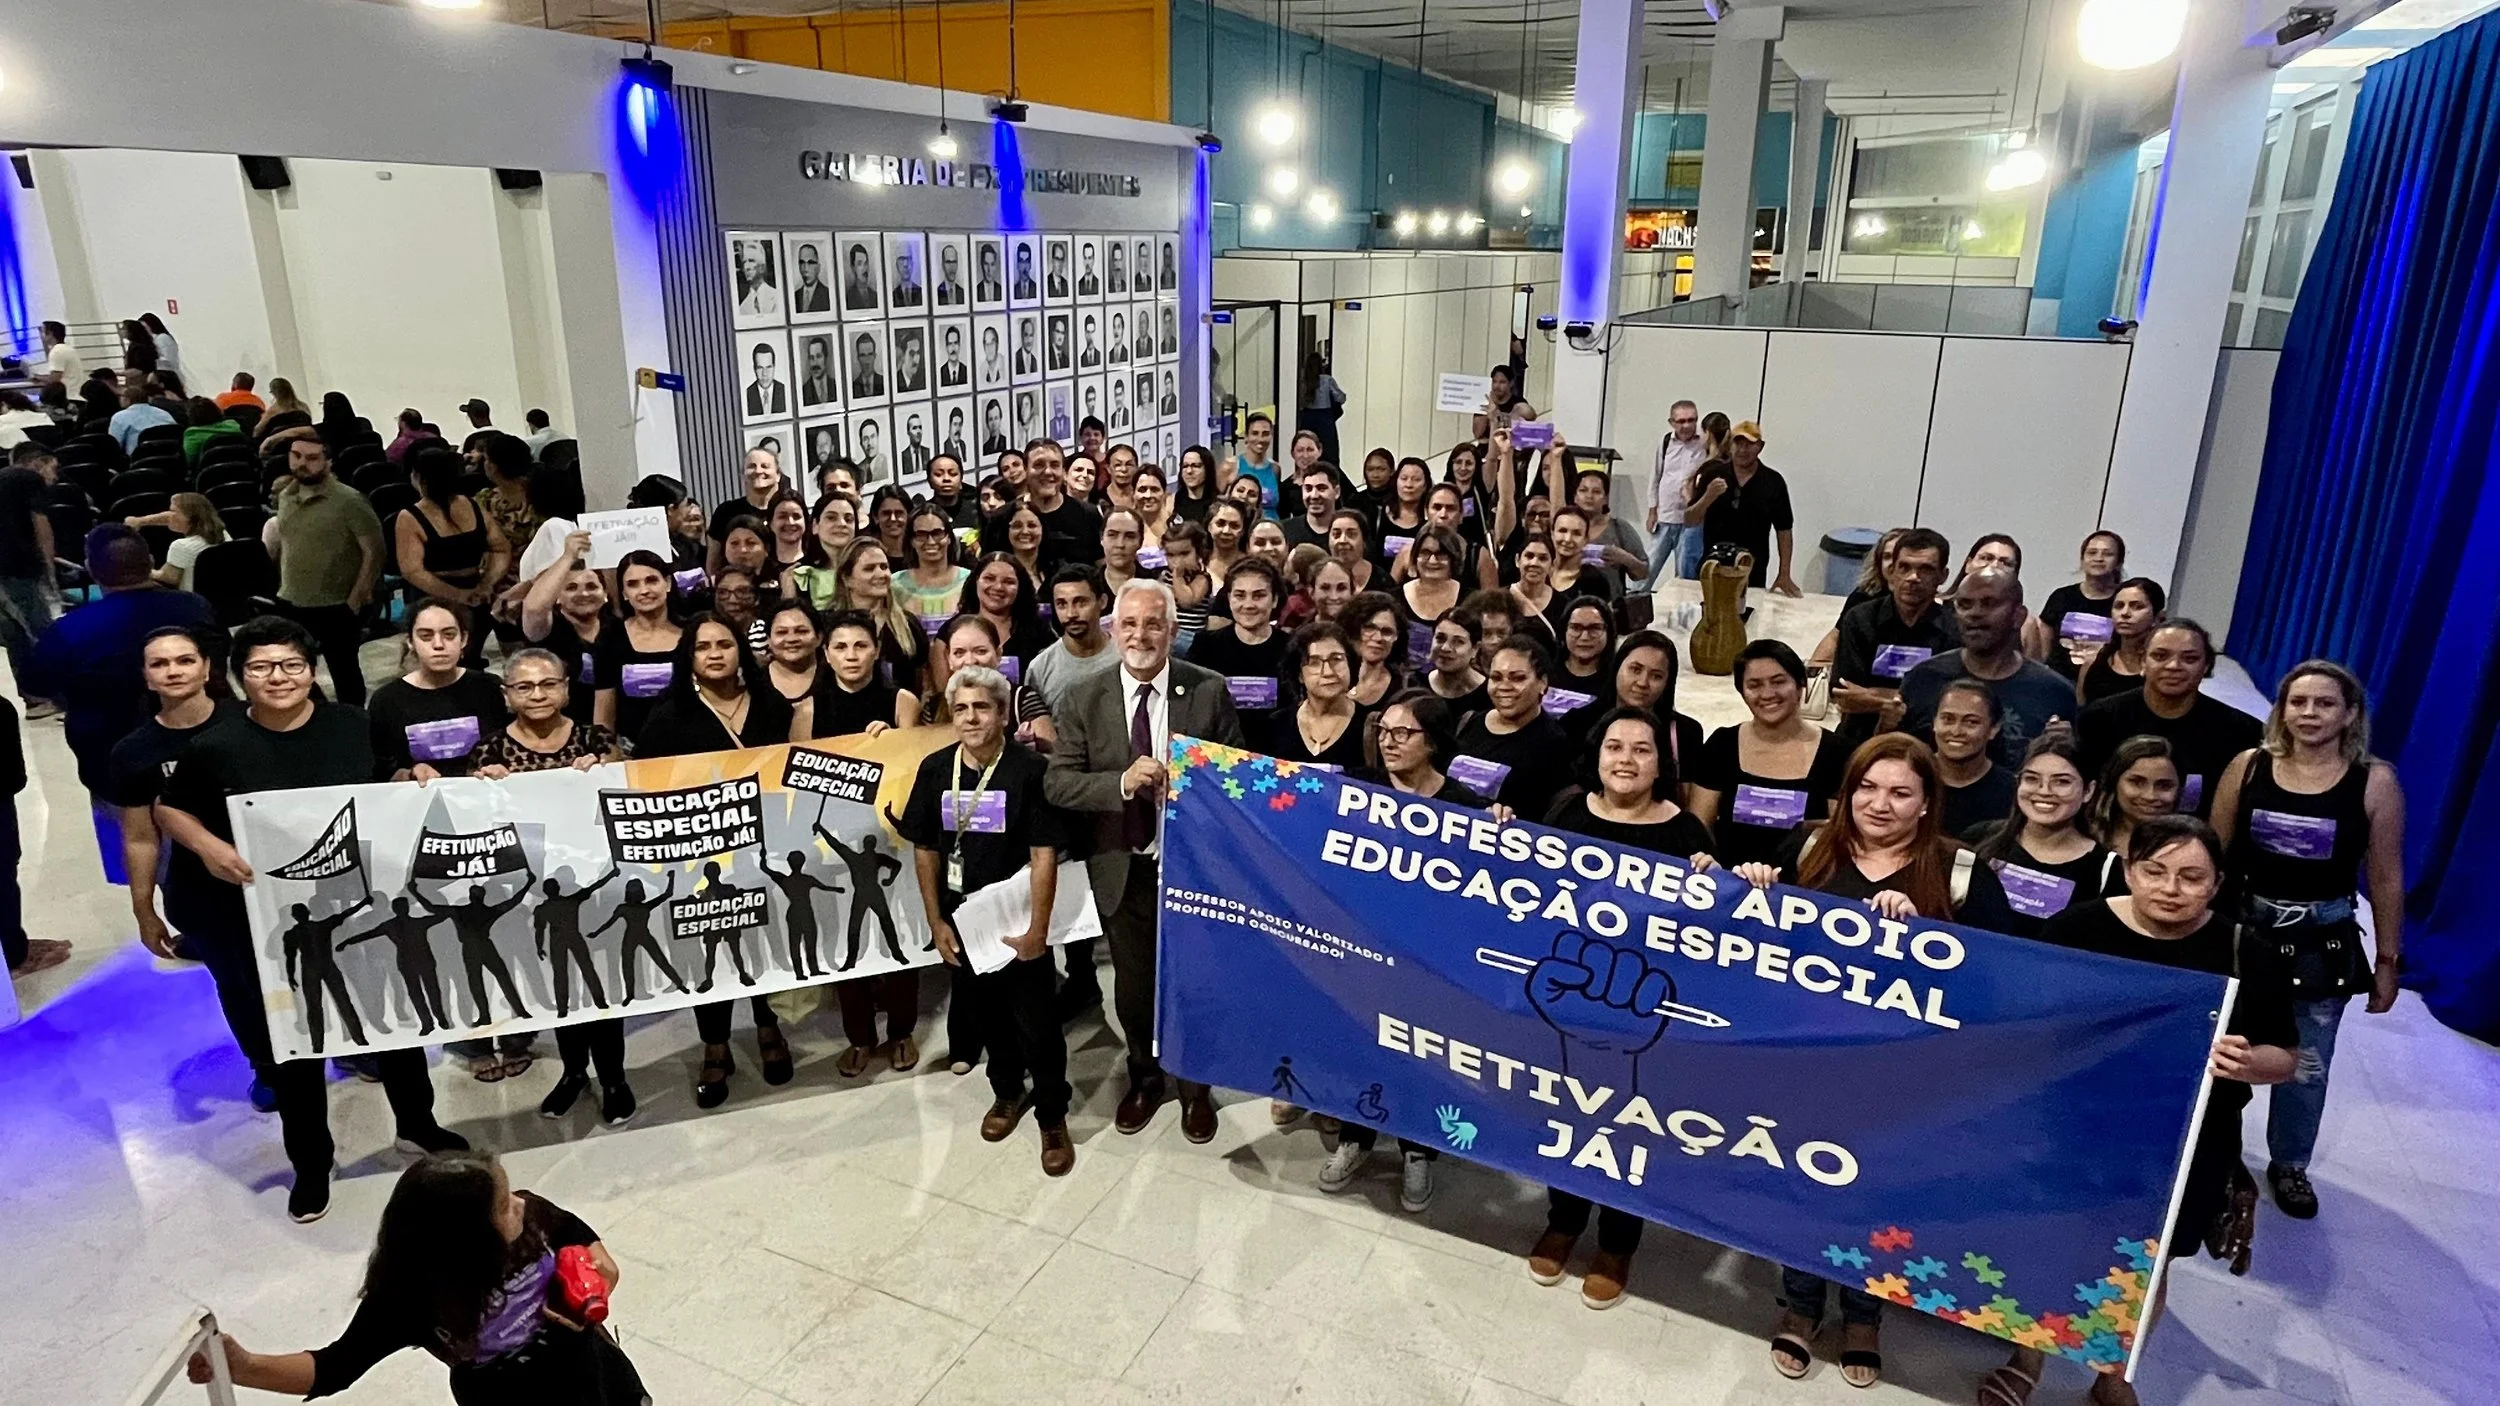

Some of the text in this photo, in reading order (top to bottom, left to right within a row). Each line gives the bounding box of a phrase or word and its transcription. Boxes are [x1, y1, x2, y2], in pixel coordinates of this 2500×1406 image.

[800, 150, 929, 186] GALERIA
[932, 159, 966, 187] DE
[791, 751, 881, 783] EDUCAÇÃO
[606, 781, 758, 816] EDUCAÇÃO
[787, 771, 866, 801] ESPECIAL
[614, 804, 758, 840] ESPECIAL
[283, 807, 352, 873] EDUCAÇÃO
[421, 829, 517, 855] EFETIVAÇÃO
[622, 826, 757, 861] EFETIVAÇÃO JÁ!
[286, 848, 352, 878] ESPECIAL
[446, 855, 497, 877] JÁ!
[1337, 784, 1966, 970] PROFESSORES APOIO
[673, 892, 765, 919] EDUCAÇÃO
[677, 912, 758, 936] ESPECIAL
[1165, 900, 1345, 959] PROFESSOR CONCURSADO!
[1166, 887, 1395, 966] PROFESSOR APOIO VALORIZADO É
[1320, 828, 1961, 1030] EDUCAÇÃO ESPECIAL
[1377, 1012, 1859, 1187] EFETIVAÇÃO
[1538, 1119, 1647, 1186] JÁ!
